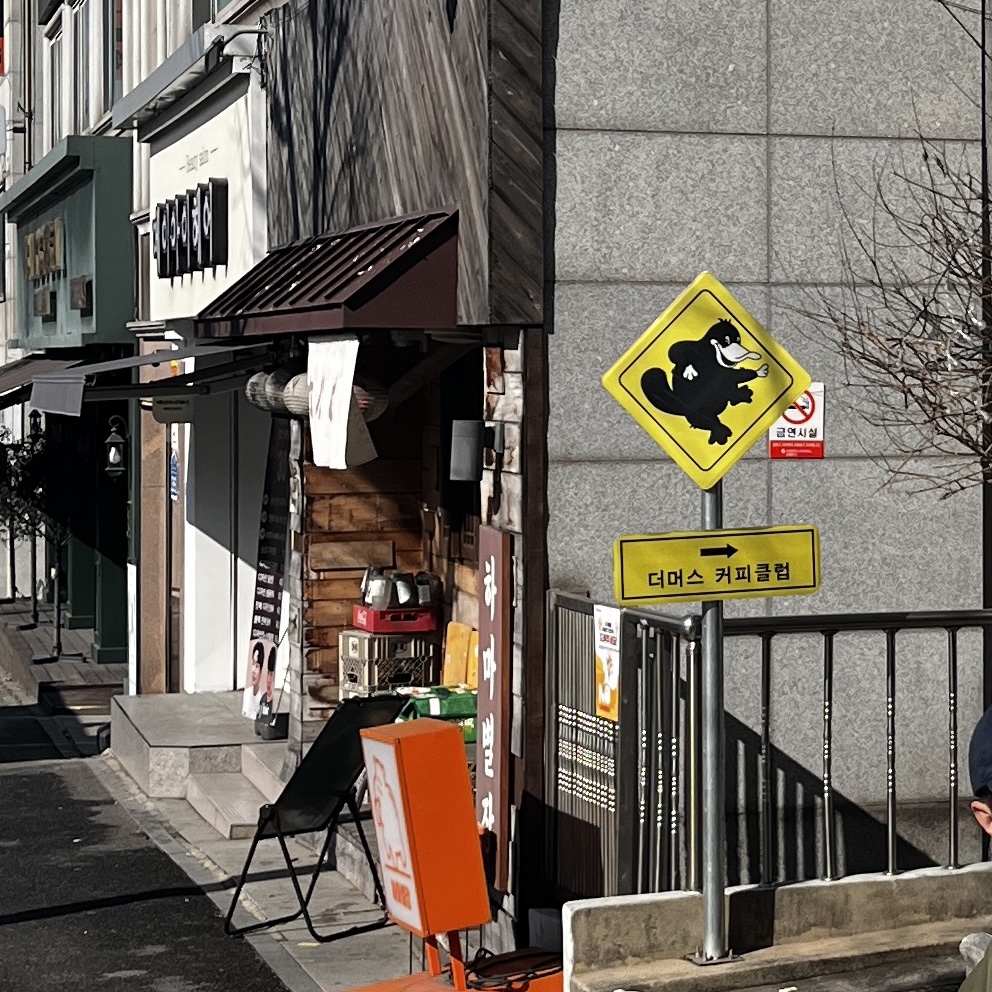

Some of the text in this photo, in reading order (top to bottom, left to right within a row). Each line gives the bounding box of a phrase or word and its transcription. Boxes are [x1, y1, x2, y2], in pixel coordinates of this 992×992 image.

[776, 427, 818, 438] 금연시설
[648, 562, 790, 588] 더머스 커피클럽
